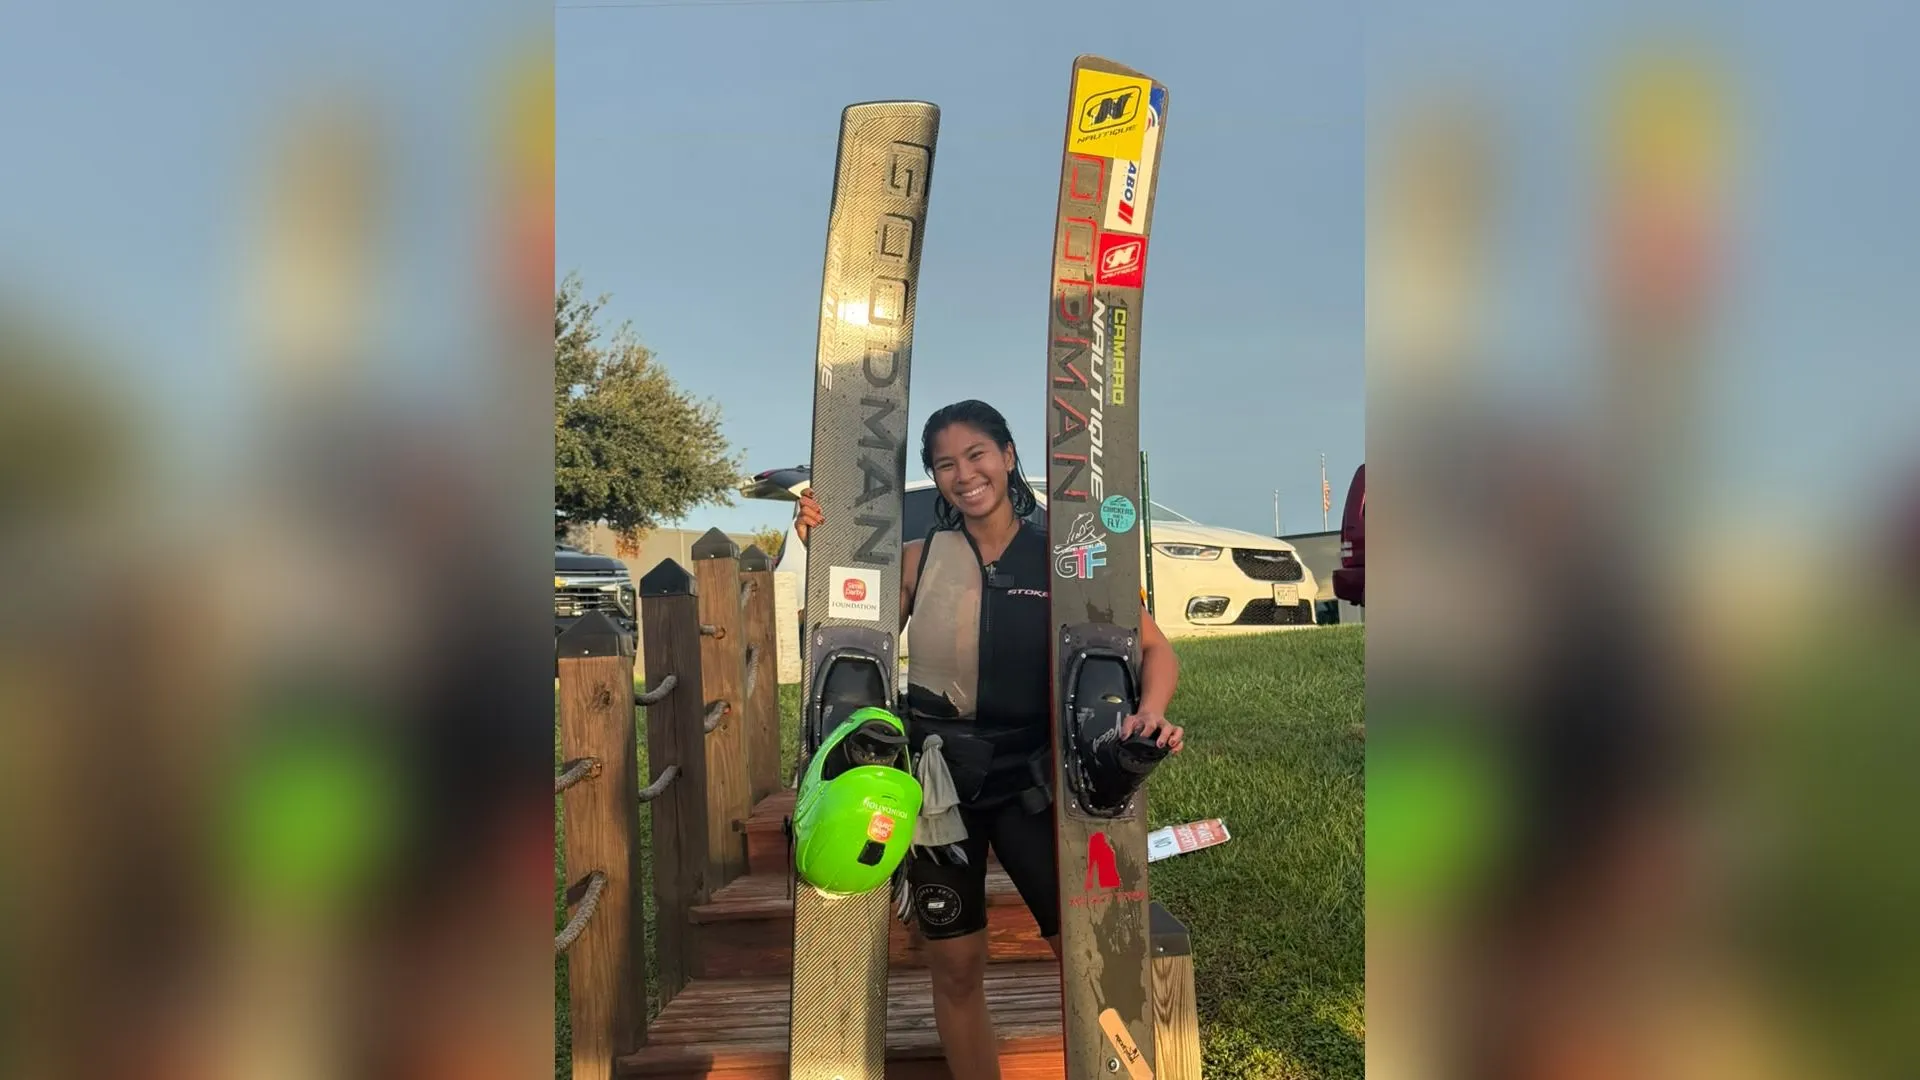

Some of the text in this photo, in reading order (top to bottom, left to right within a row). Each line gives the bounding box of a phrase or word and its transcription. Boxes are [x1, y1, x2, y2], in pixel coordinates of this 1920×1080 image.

[853, 140, 932, 566] GOODMAN
[1052, 154, 1105, 503] OODMAN
[1088, 297, 1105, 503] NAUTIQUE
[1112, 308, 1126, 404] CAMARO
[1055, 543, 1106, 578] GTF
